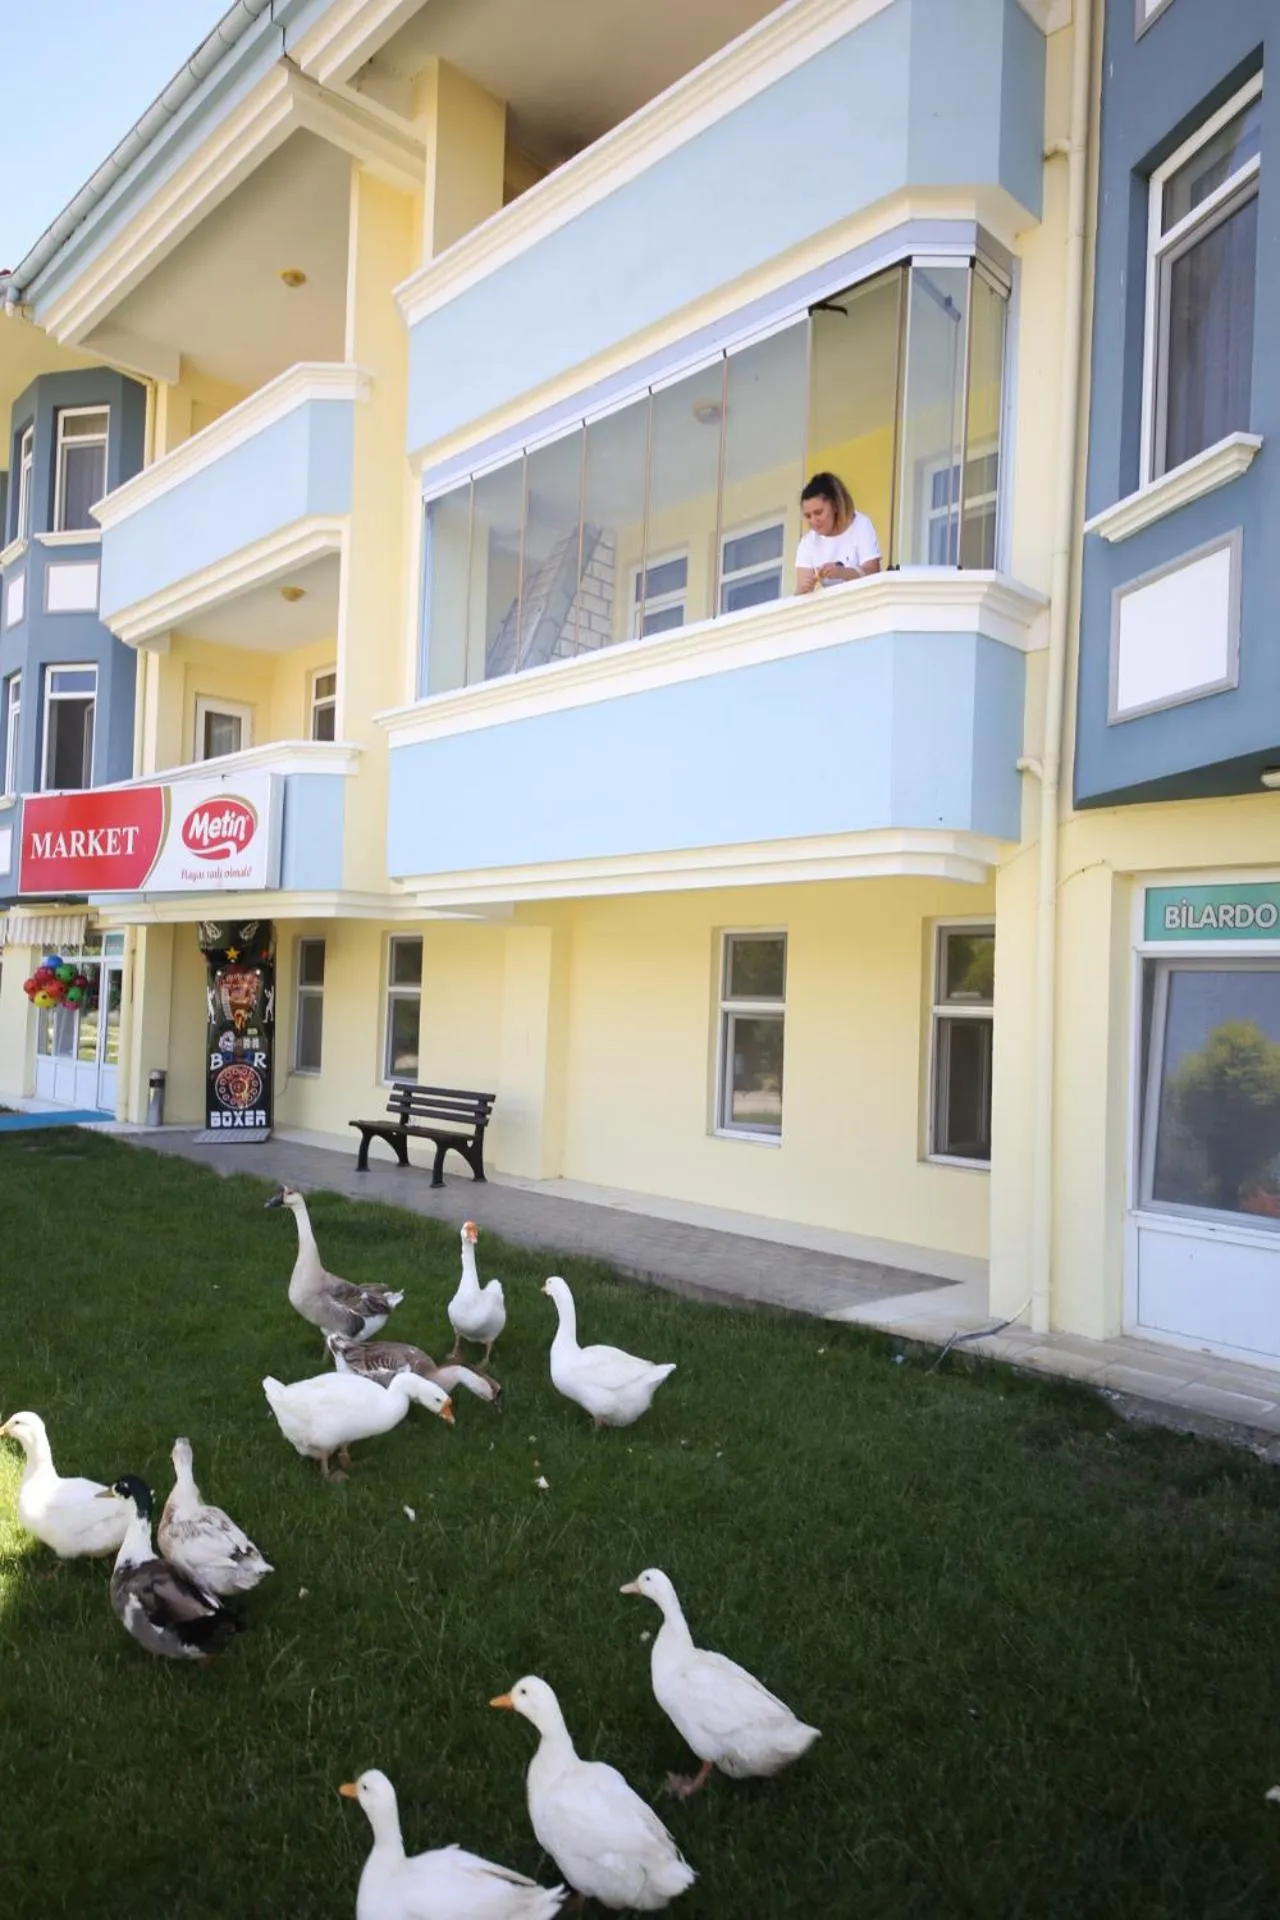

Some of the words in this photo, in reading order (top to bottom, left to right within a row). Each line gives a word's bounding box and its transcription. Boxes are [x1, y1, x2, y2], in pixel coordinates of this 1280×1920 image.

[30, 826, 140, 860] MARKET
[187, 809, 246, 847] Metin
[1164, 897, 1279, 929] BİLARDO
[210, 1110, 266, 1127] BOXER
